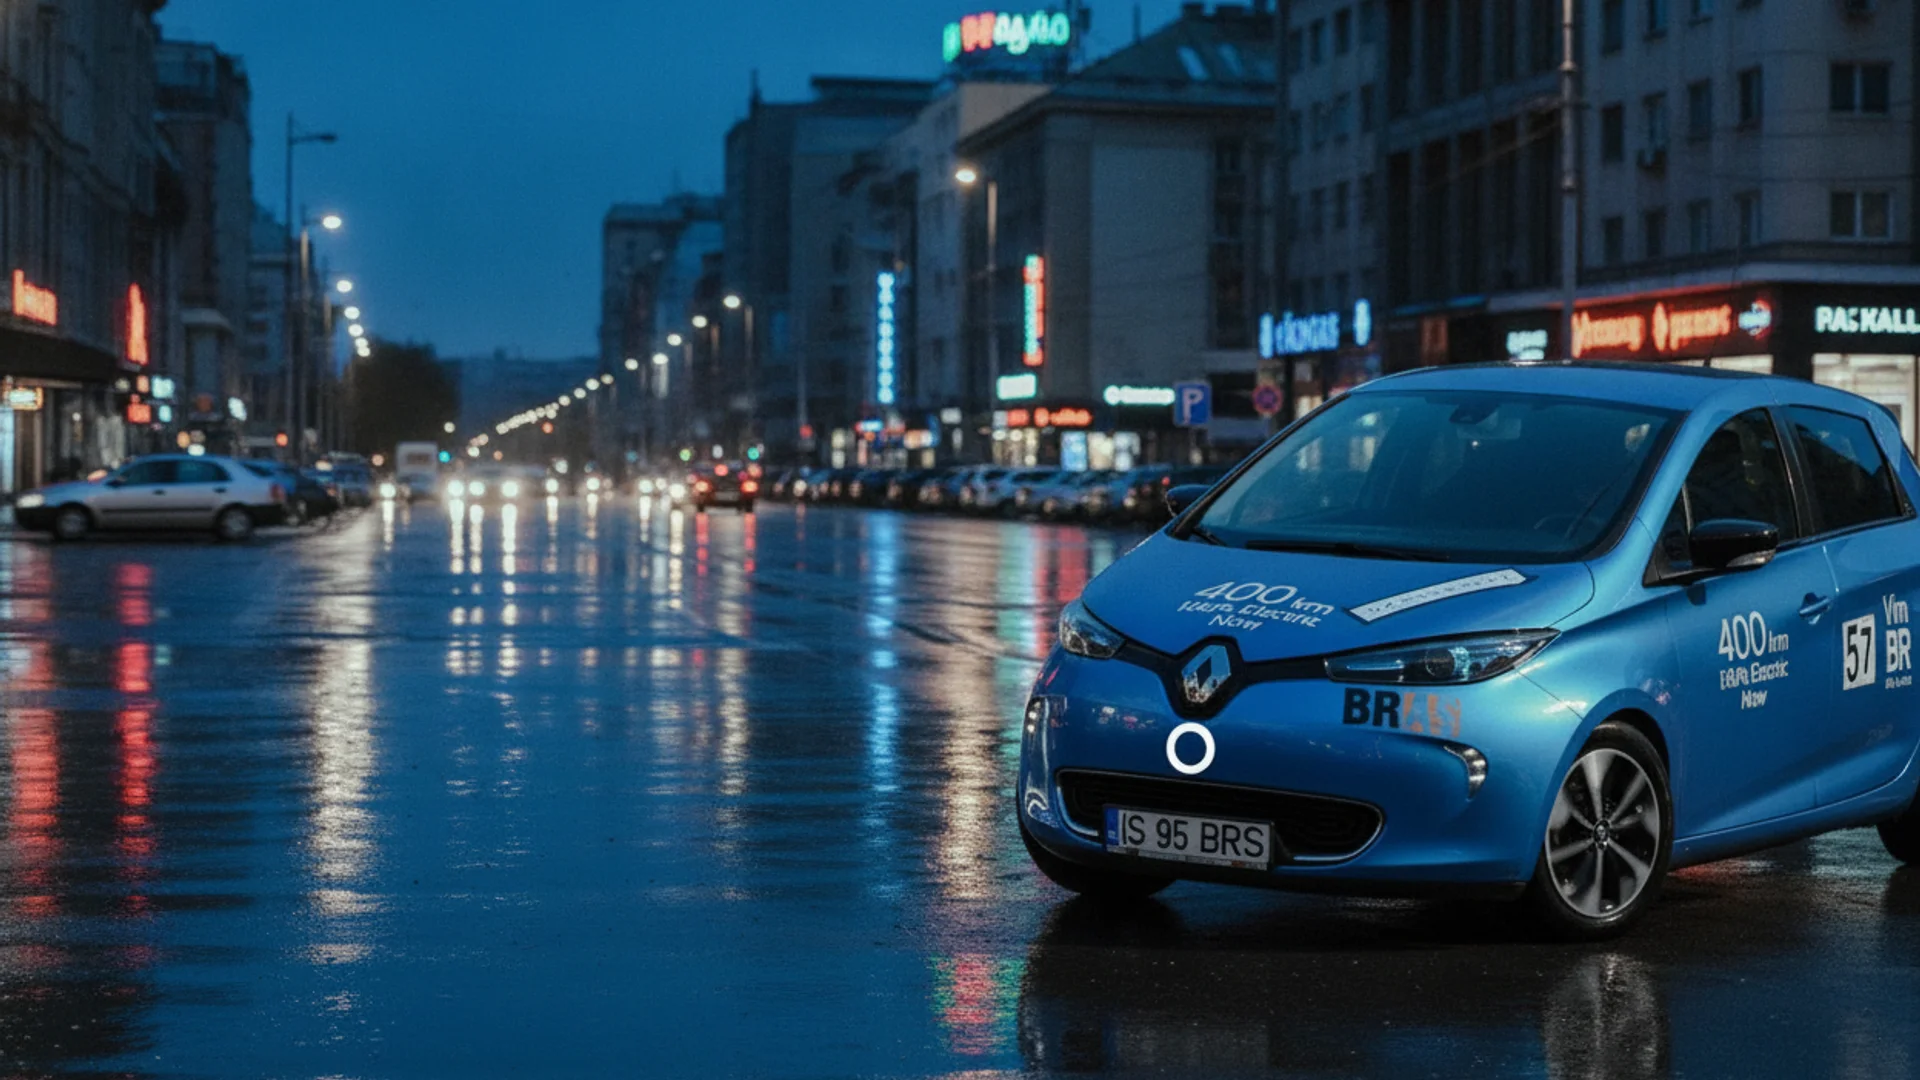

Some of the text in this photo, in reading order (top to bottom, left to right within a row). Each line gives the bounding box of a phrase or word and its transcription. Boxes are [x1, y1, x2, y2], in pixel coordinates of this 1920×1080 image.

[1183, 387, 1204, 425] P
[1194, 581, 1298, 604] 400
[1718, 610, 1766, 661] 400
[1846, 624, 1872, 682] 57
[1886, 627, 1912, 673] BR
[1122, 812, 1264, 858] IS 95 BRS
